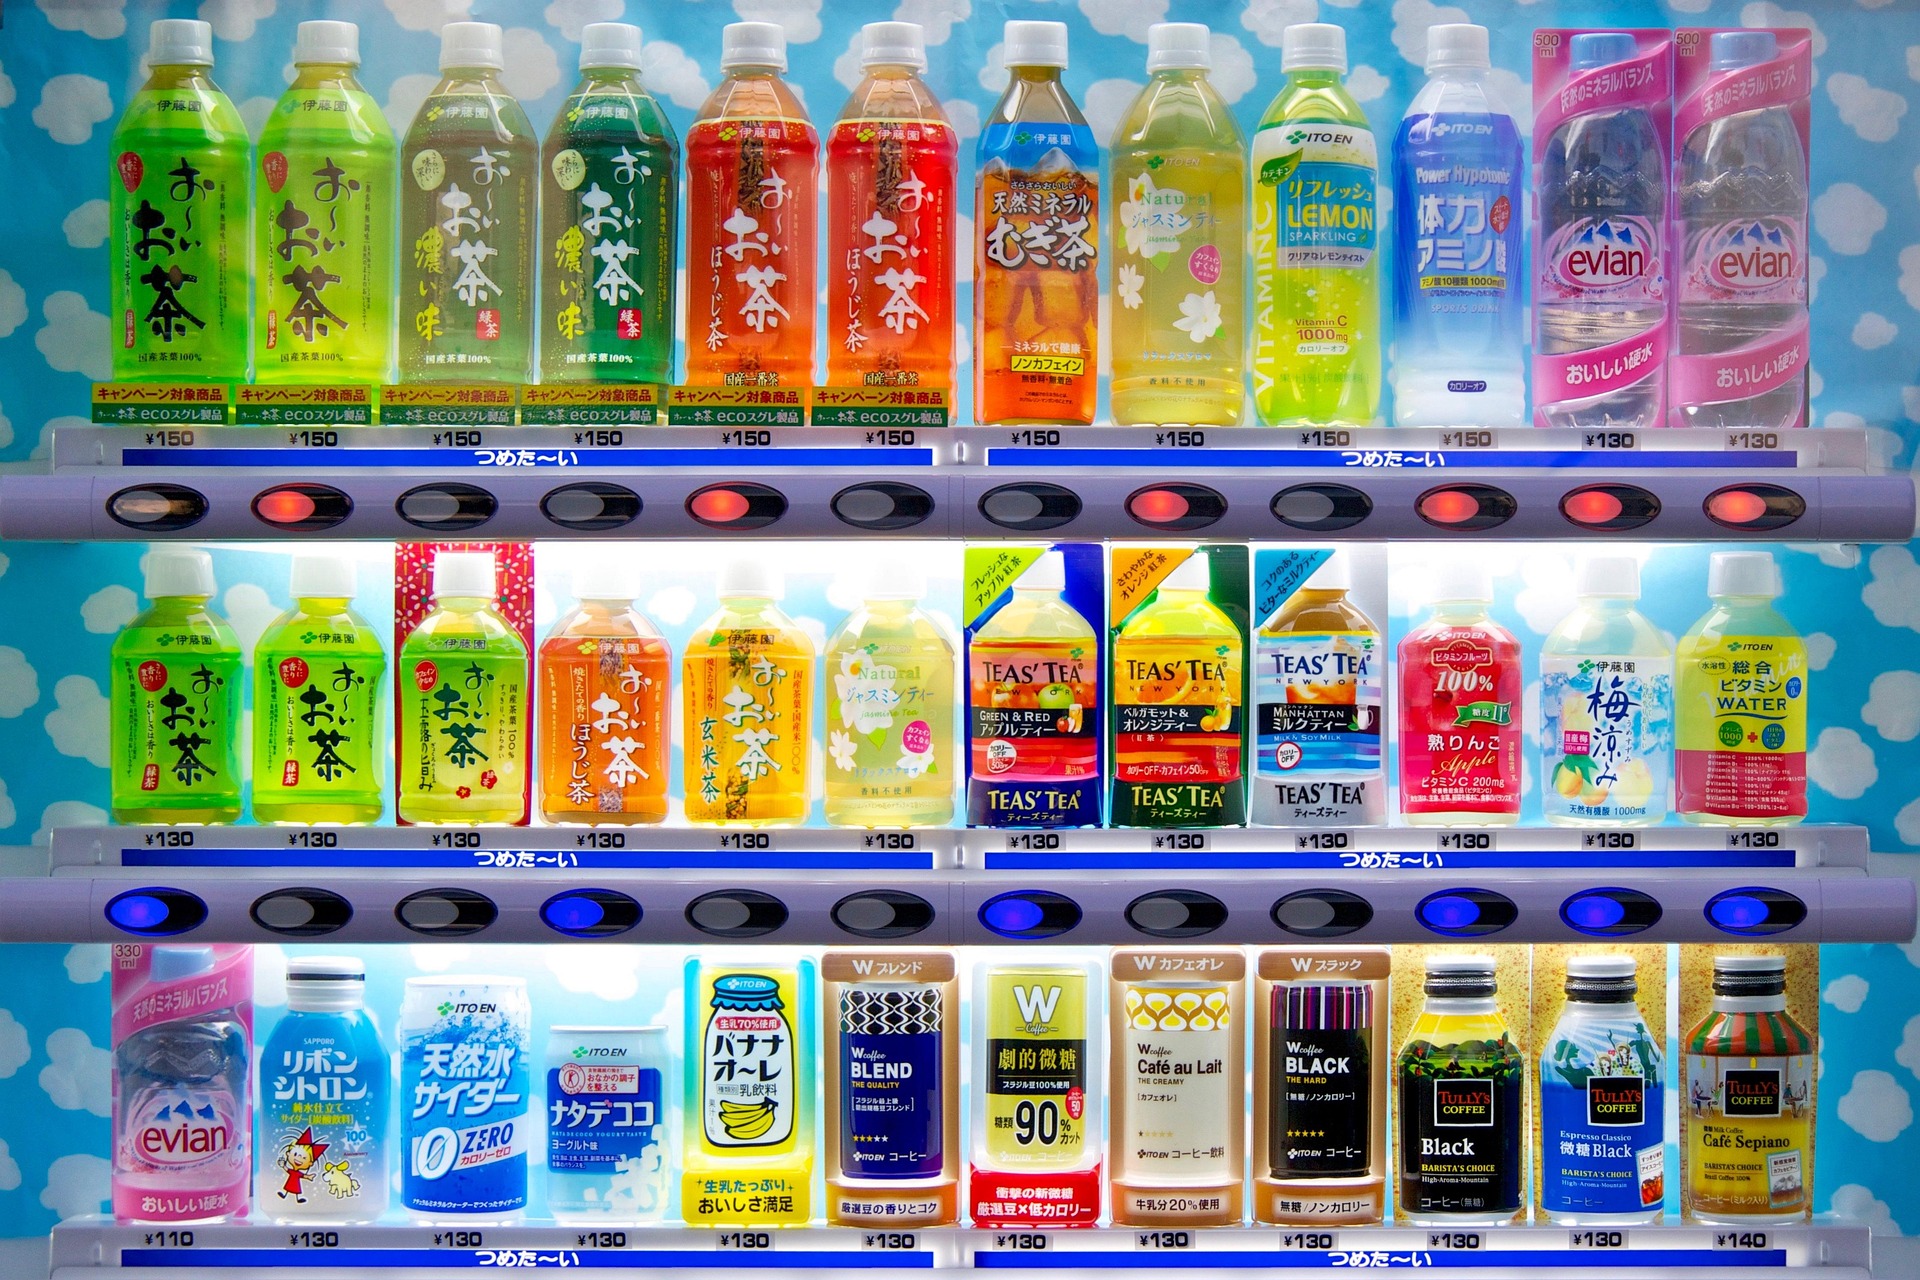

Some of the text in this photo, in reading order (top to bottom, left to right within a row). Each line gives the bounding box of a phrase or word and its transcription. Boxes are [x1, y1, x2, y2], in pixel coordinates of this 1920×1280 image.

[1535, 35, 1559, 46] 500
[1540, 46, 1555, 56] ml
[1561, 63, 1654, 112] 天然のミネラルバランス
[157, 100, 200, 112] 伊藤園
[446, 106, 488, 119] 伊藤園
[586, 105, 628, 119] 伊藤園
[877, 130, 919, 141] 伊藤園
[1034, 133, 1071, 145] 伊藤園
[1416, 166, 1510, 186] Power Hypotonic
[1141, 192, 1212, 205] Natural
[1288, 181, 1373, 201] リフレッシュ
[992, 194, 1091, 215] 天然ミネラル
[1287, 204, 1373, 230] LEMON
[1419, 195, 1485, 235] 体力
[987, 217, 1097, 271] むぎ茶
[1289, 232, 1356, 242] SPARKLING
[1568, 245, 1644, 277] evian
[1719, 247, 1792, 278] evian
[706, 247, 729, 352] ほうじ茶
[844, 248, 869, 353] ほうじ茶
[1296, 329, 1348, 343] 1000mg
[1299, 345, 1345, 353] カロリーオフ
[138, 352, 202, 362] 国産茶葉100%
[426, 354, 491, 364] 国産茶葉100%
[566, 353, 633, 363] 国産茶葉100%
[1012, 357, 1082, 372] ノンカフェイン
[1567, 342, 1653, 385] おいしい硬水
[1717, 345, 1799, 388] おいしい硬水
[1449, 382, 1485, 391] カロリーオフ
[98, 388, 222, 401] キャンペーン対象商品
[241, 389, 366, 401] キャンペーン対象商品
[527, 390, 651, 402] キャンペーン対象商品
[818, 391, 942, 404] キャンペーン対象商品
[146, 431, 194, 446] ¥150
[290, 431, 338, 446] ¥150
[434, 431, 481, 446] ¥150
[574, 431, 622, 446] ¥150
[722, 431, 770, 446] ¥150
[866, 431, 914, 446] ¥150
[1012, 431, 1060, 446] ¥150
[1156, 431, 1204, 446] ¥150
[1302, 431, 1350, 446] ¥150
[1443, 431, 1491, 446] ¥150
[1587, 433, 1634, 448] ¥130
[1729, 433, 1777, 448] ¥130
[974, 556, 1022, 606] アップル紅茶
[1120, 554, 1167, 601] オレンジ紅茶
[175, 635, 212, 645] 伊藤園
[318, 633, 355, 644] 伊藤園
[728, 635, 774, 646] 伊藤園
[599, 642, 639, 654] 伊藤園
[1435, 652, 1489, 662] ビタミンフルーツ
[858, 667, 920, 680] Natural
[1596, 662, 1635, 673] 伊藤園
[1732, 661, 1771, 675] 総合
[1434, 671, 1494, 692] 100%
[1721, 680, 1781, 692] ビタミン
[846, 687, 934, 703] ジャスミンティー
[1718, 698, 1786, 710] WATER
[1273, 707, 1344, 718] MANHATTAN
[980, 723, 1056, 736] アップルティー
[1124, 720, 1197, 732] オレンジティー
[1272, 718, 1347, 731] ミルクティー
[1428, 735, 1500, 751] 熟りんご
[567, 723, 594, 805] ほうじ茶
[700, 717, 721, 804] 玄米茶
[1431, 751, 1496, 775] Apple
[1150, 809, 1206, 818] ティーズティー
[1294, 808, 1347, 818] ティーズティー
[1569, 805, 1646, 815] 天然有機酸 1000mg
[146, 831, 194, 846] ¥130
[289, 832, 337, 847] ¥130
[433, 833, 481, 847] ¥130
[577, 833, 625, 847] ¥130
[721, 834, 769, 849] ¥130
[865, 834, 914, 849] ¥130
[1011, 834, 1059, 849] ¥130
[1156, 834, 1204, 849] ¥130
[1299, 833, 1347, 848] ¥130
[1442, 833, 1489, 848] ¥130
[1586, 833, 1634, 847] ¥130
[1731, 832, 1778, 846] ¥130
[876, 962, 922, 976] ブレンド
[1159, 957, 1224, 971] カフェオレ
[1315, 959, 1362, 972] ブラック
[713, 1032, 784, 1057] バナナ
[283, 1048, 357, 1074] リボン
[421, 1044, 518, 1078] 天然水
[998, 1048, 1076, 1071] 劇的微糖
[1138, 1059, 1222, 1075] Café au Lait
[1286, 1057, 1350, 1074] BLACK
[851, 1063, 912, 1078] BLEND
[273, 1076, 367, 1101] シトロン
[413, 1080, 519, 1119] サイダー
[551, 1101, 654, 1127] ナタデココ
[1443, 1105, 1485, 1114] COFFEE
[1597, 1104, 1637, 1113] COFFEE
[1015, 1101, 1058, 1145] 90
[143, 1123, 228, 1153] evian
[464, 1123, 513, 1153] ZERO
[552, 1140, 598, 1151] ヨーグルト味
[1703, 1134, 1790, 1152] Café Sepiano
[1421, 1138, 1474, 1156] Black
[1560, 1141, 1632, 1158] 微糖 Black
[460, 1146, 511, 1166] カロリーゼロ
[1421, 1164, 1464, 1172] BARISTA'S
[705, 1179, 785, 1193] 生乳たっぷり
[996, 1187, 1073, 1200] 衝撃の新微糖
[142, 1193, 228, 1213] おいしい硬水
[698, 1197, 793, 1214] おいしさ満足
[841, 1202, 937, 1215] 厳選豆の香りとコク
[1136, 1198, 1219, 1211] 牛乳分20%使用
[145, 1232, 193, 1246] ¥110
[290, 1232, 339, 1247] ¥130
[434, 1232, 482, 1246] ¥130
[578, 1233, 626, 1247] ¥130
[721, 1233, 769, 1248] ¥130
[866, 1234, 915, 1249] ¥130
[997, 1234, 1046, 1249] ¥130
[1140, 1232, 1188, 1248] ¥130
[1284, 1234, 1332, 1248] ¥130
[1432, 1234, 1480, 1248] ¥130
[1574, 1232, 1622, 1247] ¥130
[1718, 1233, 1766, 1248] ¥140
